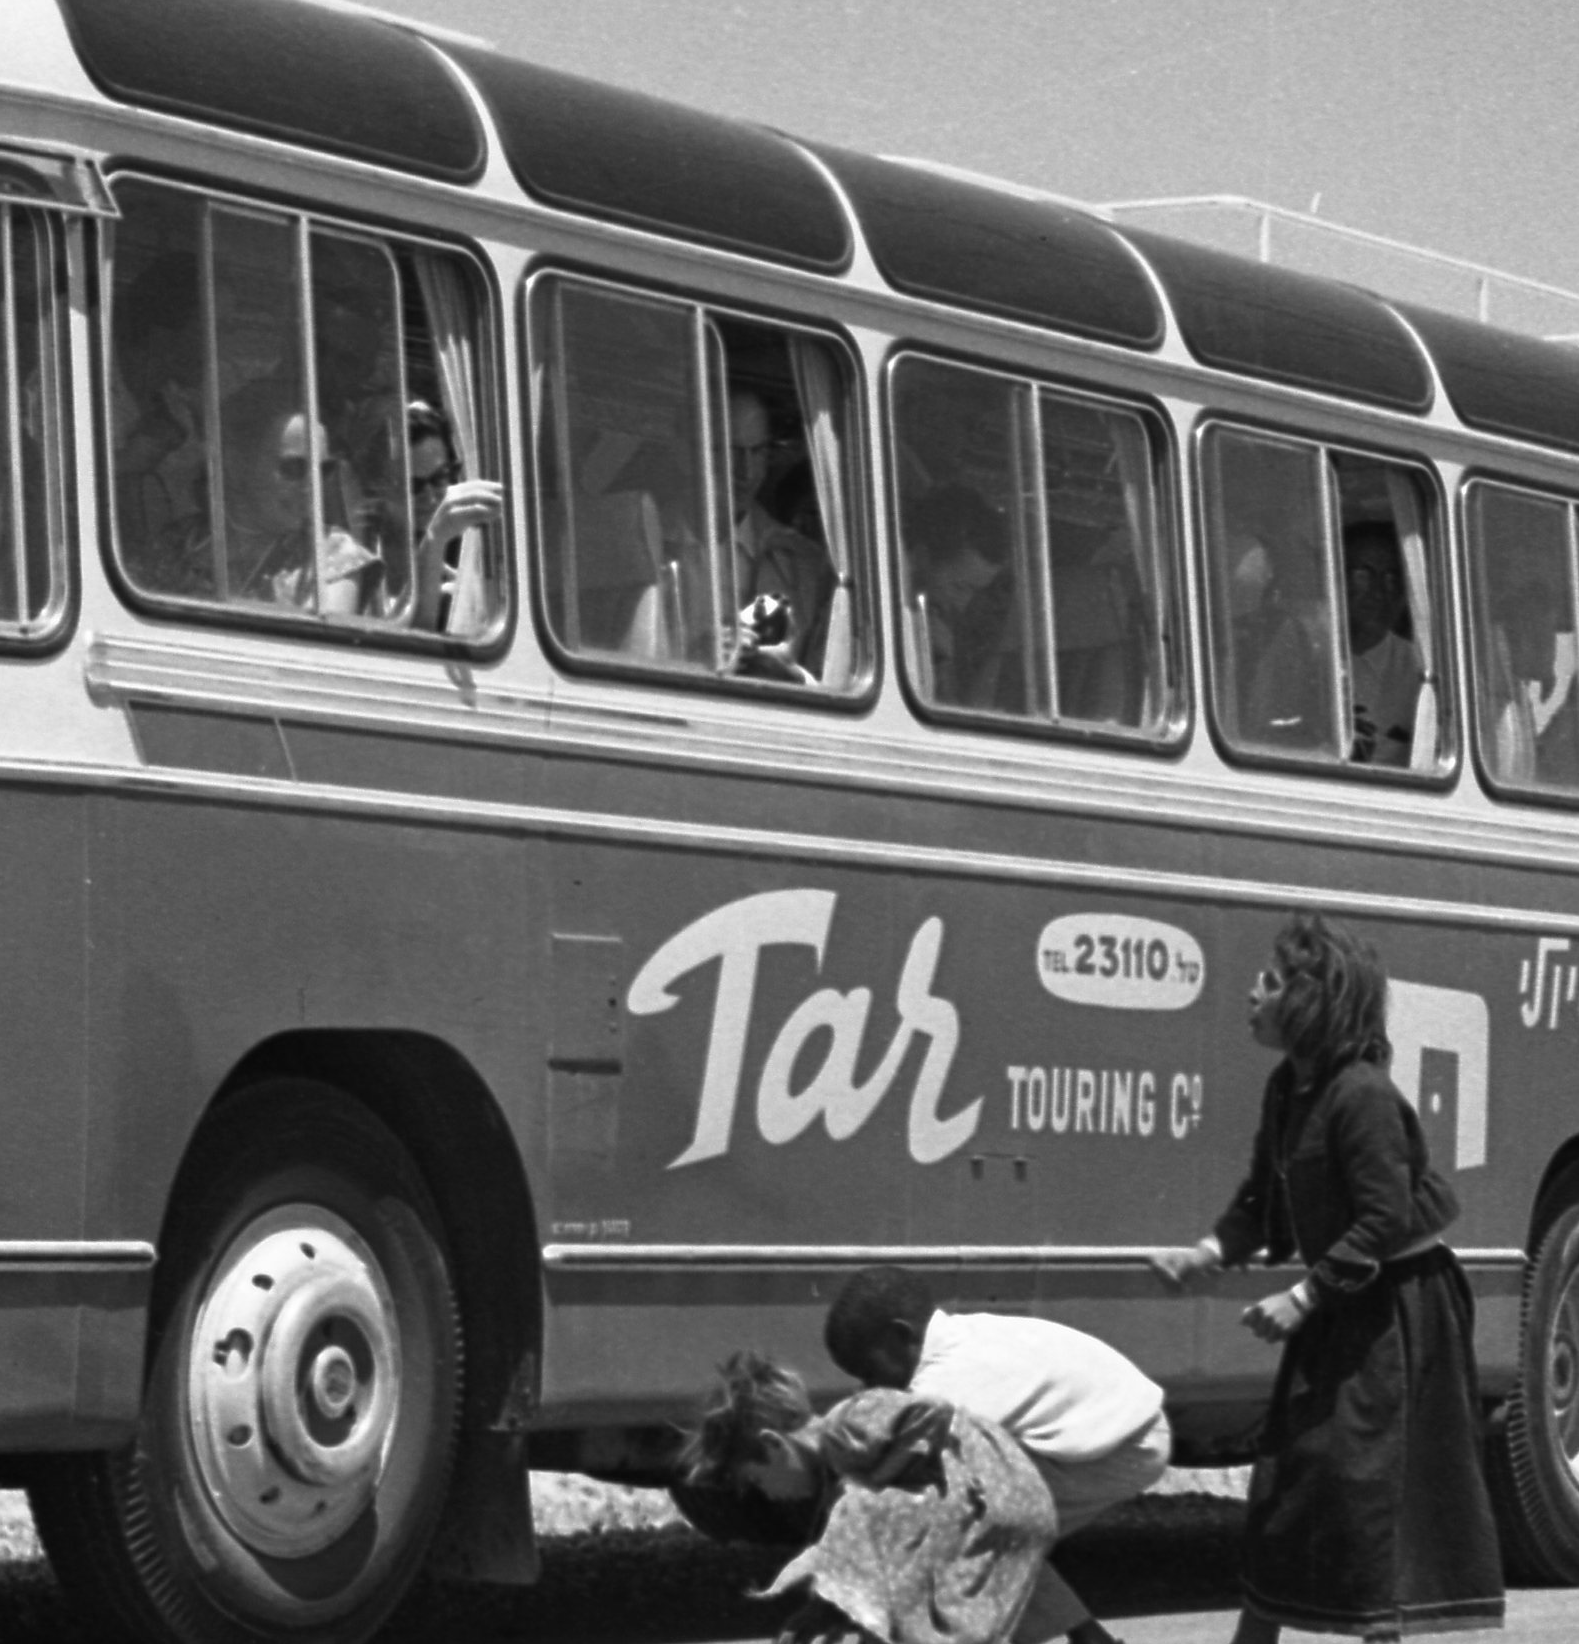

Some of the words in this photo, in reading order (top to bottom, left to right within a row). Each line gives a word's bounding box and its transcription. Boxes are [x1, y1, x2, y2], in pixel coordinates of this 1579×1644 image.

[1073, 933, 1169, 982] 23110
[626, 887, 985, 1171] Tar
[1006, 1063, 1156, 1138] TOURING
